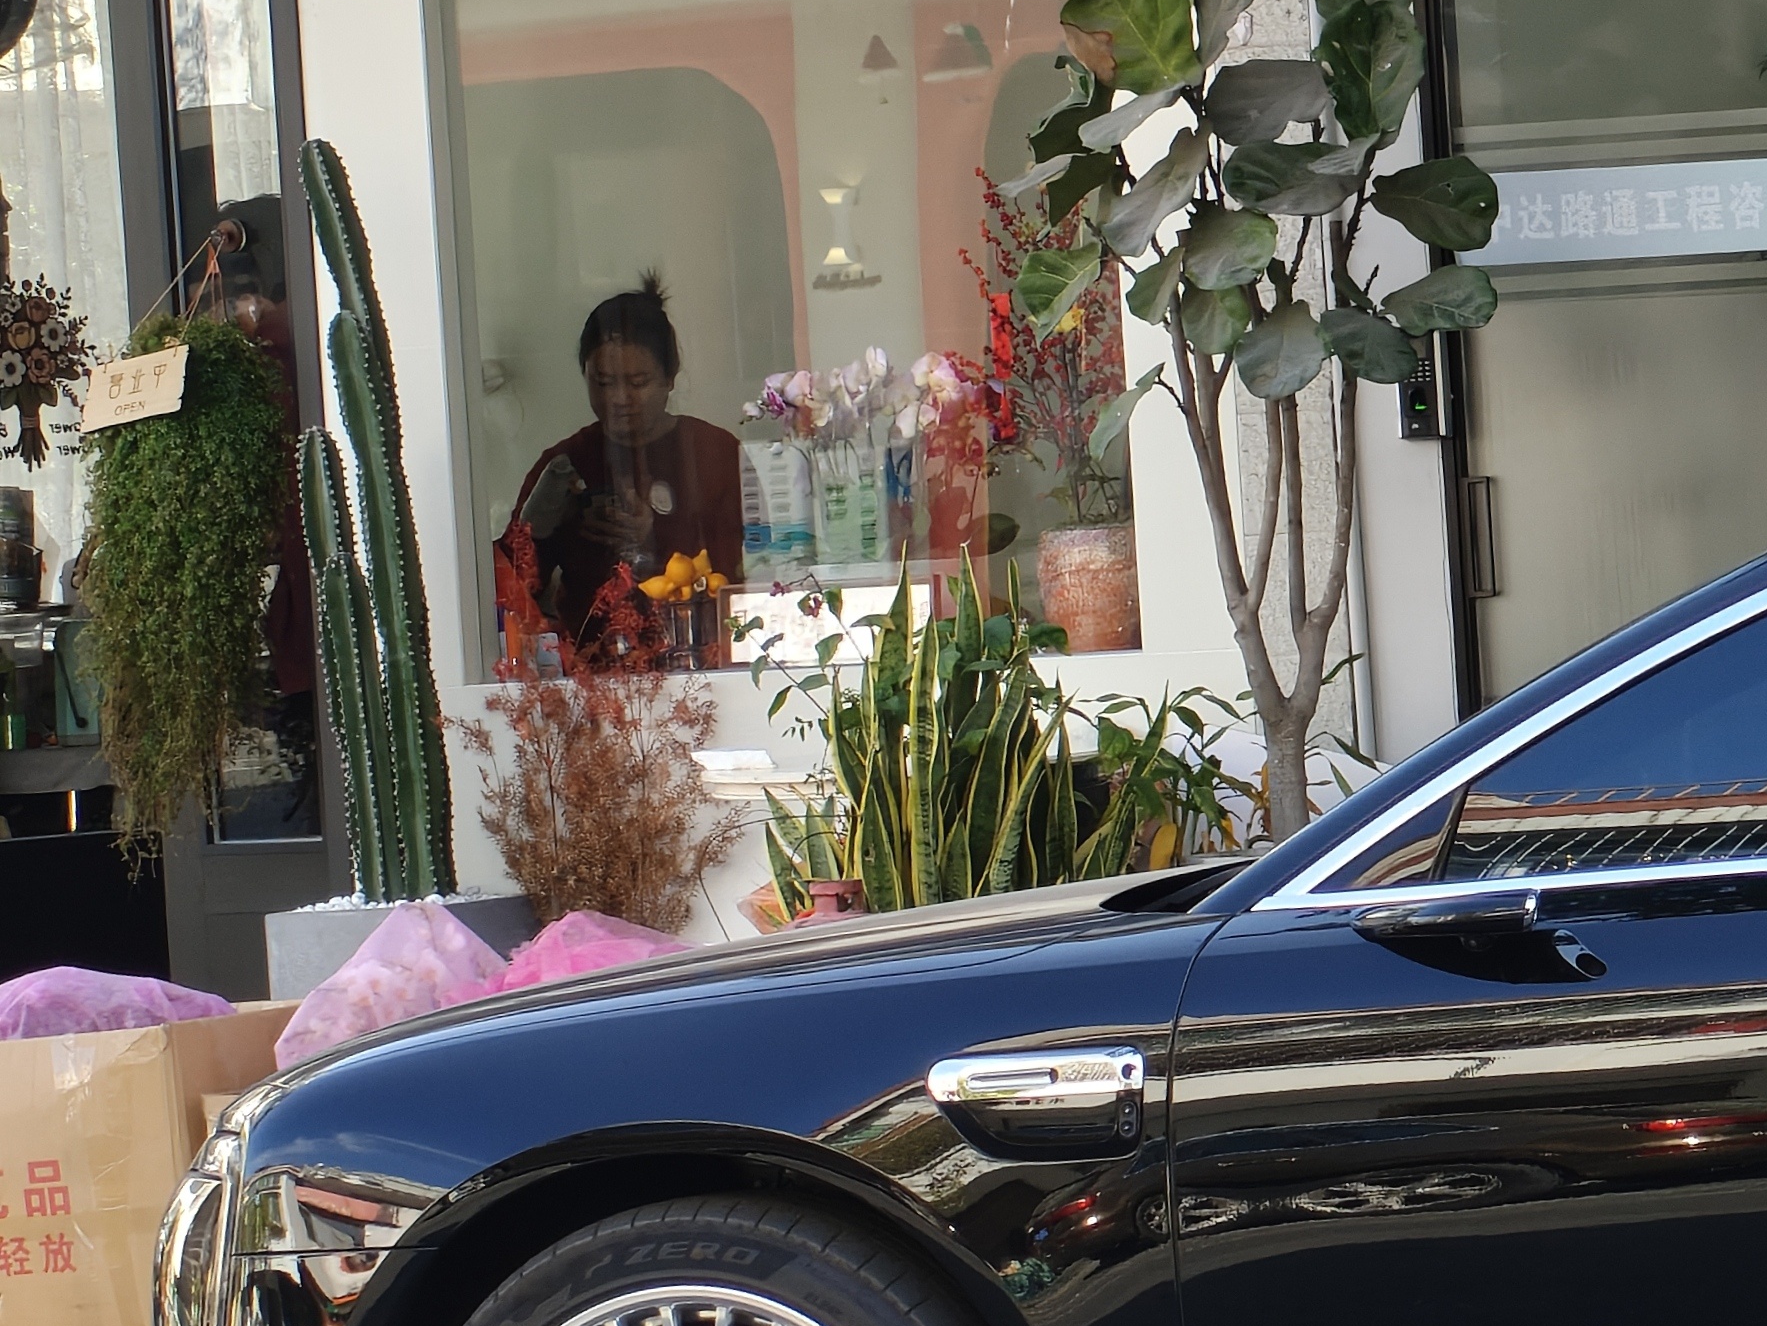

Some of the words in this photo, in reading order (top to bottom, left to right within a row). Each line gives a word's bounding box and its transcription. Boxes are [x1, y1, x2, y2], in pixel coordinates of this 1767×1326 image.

[114, 400, 147, 417] OPEN
[0, 1159, 71, 1219] 品
[623, 1240, 761, 1268] ZERO
